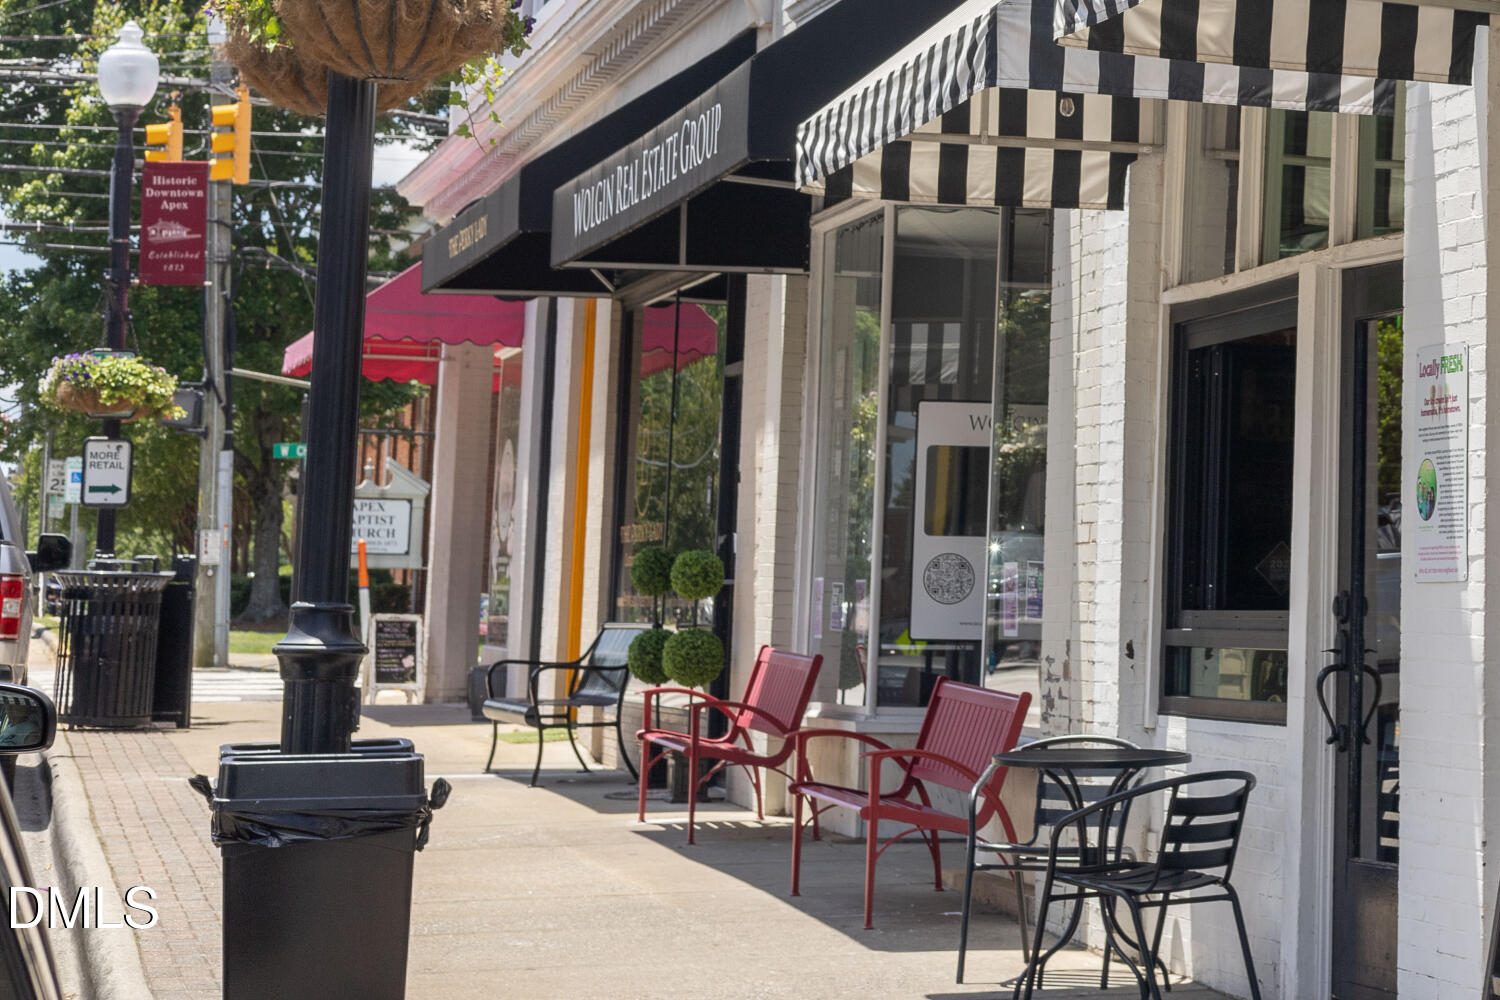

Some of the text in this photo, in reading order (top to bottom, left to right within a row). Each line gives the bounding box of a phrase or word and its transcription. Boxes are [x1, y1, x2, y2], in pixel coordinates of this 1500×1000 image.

[573, 103, 722, 238] WOLGIN REAL ESTATE GROUP
[152, 175, 197, 185] Historic
[145, 187, 204, 198] Downtown
[160, 200, 189, 211] Apex
[89, 451, 121, 460] MORE
[88, 460, 126, 470] RETAIL
